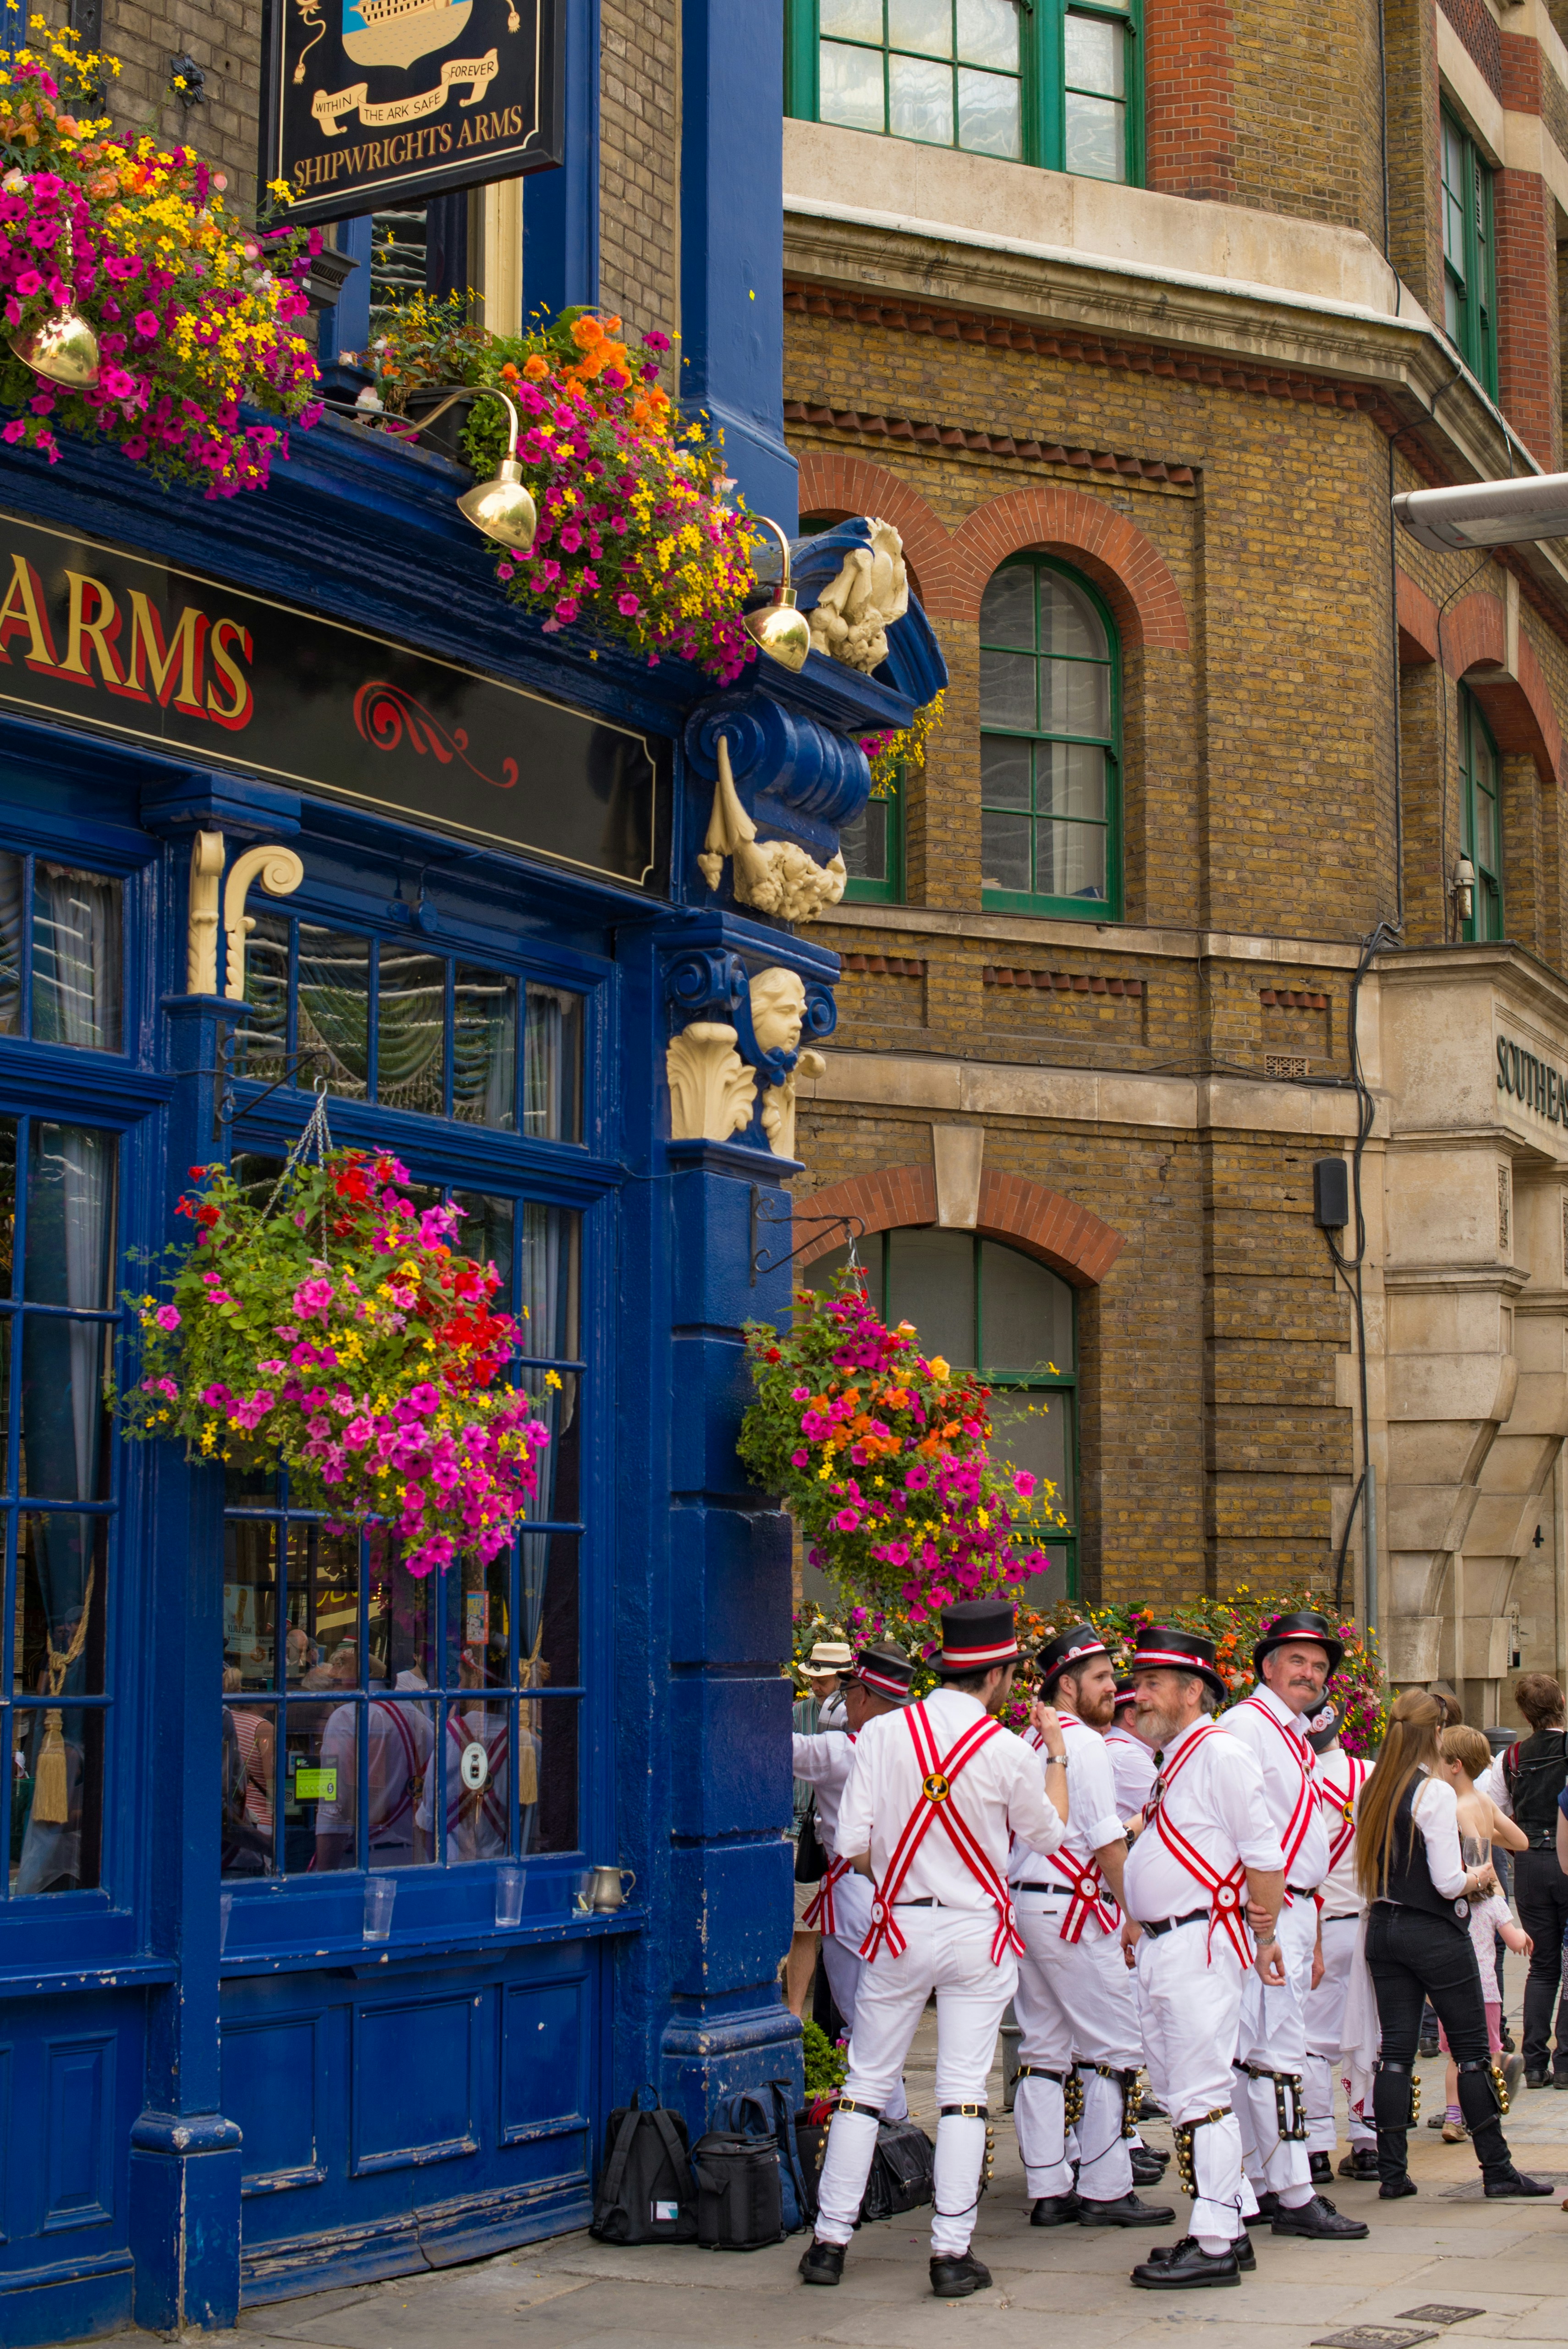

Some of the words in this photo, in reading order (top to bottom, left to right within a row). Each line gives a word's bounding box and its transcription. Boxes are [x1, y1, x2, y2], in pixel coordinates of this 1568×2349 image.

[315, 93, 352, 113] WITHIN
[364, 108, 384, 121] THE
[387, 104, 409, 119] ARK
[414, 92, 441, 115] SAFE
[450, 61, 494, 78] FOREVER
[294, 123, 452, 187] SHIPWRIGHTS
[456, 105, 523, 148] ARMS
[0, 554, 253, 731] ARMS
